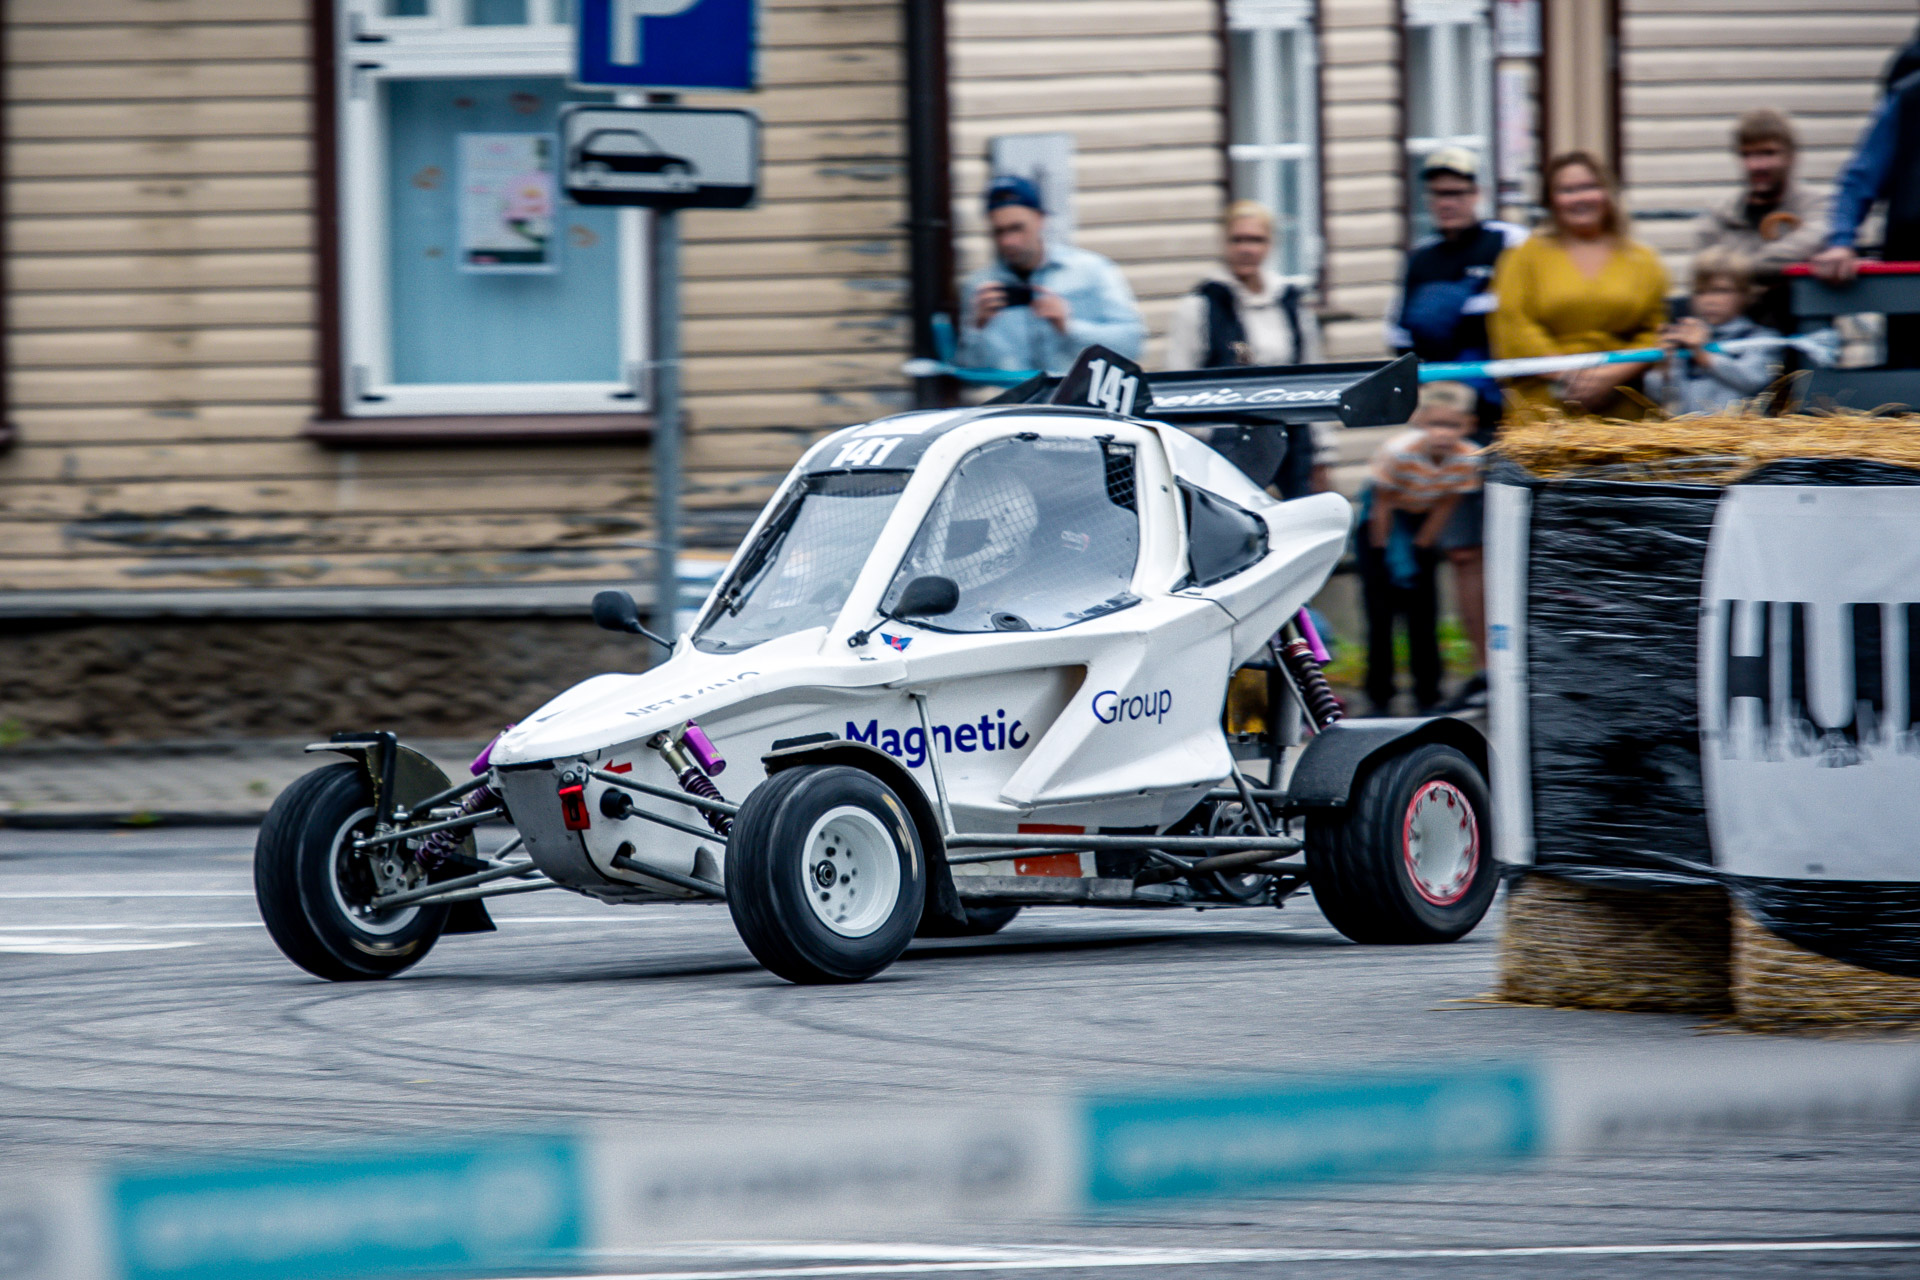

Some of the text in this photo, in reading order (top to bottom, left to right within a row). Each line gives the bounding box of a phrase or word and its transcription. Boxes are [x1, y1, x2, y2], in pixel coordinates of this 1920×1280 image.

[1087, 358, 1139, 416] 141
[830, 437, 904, 467] 141
[846, 690, 1172, 768] Magnetic Group
